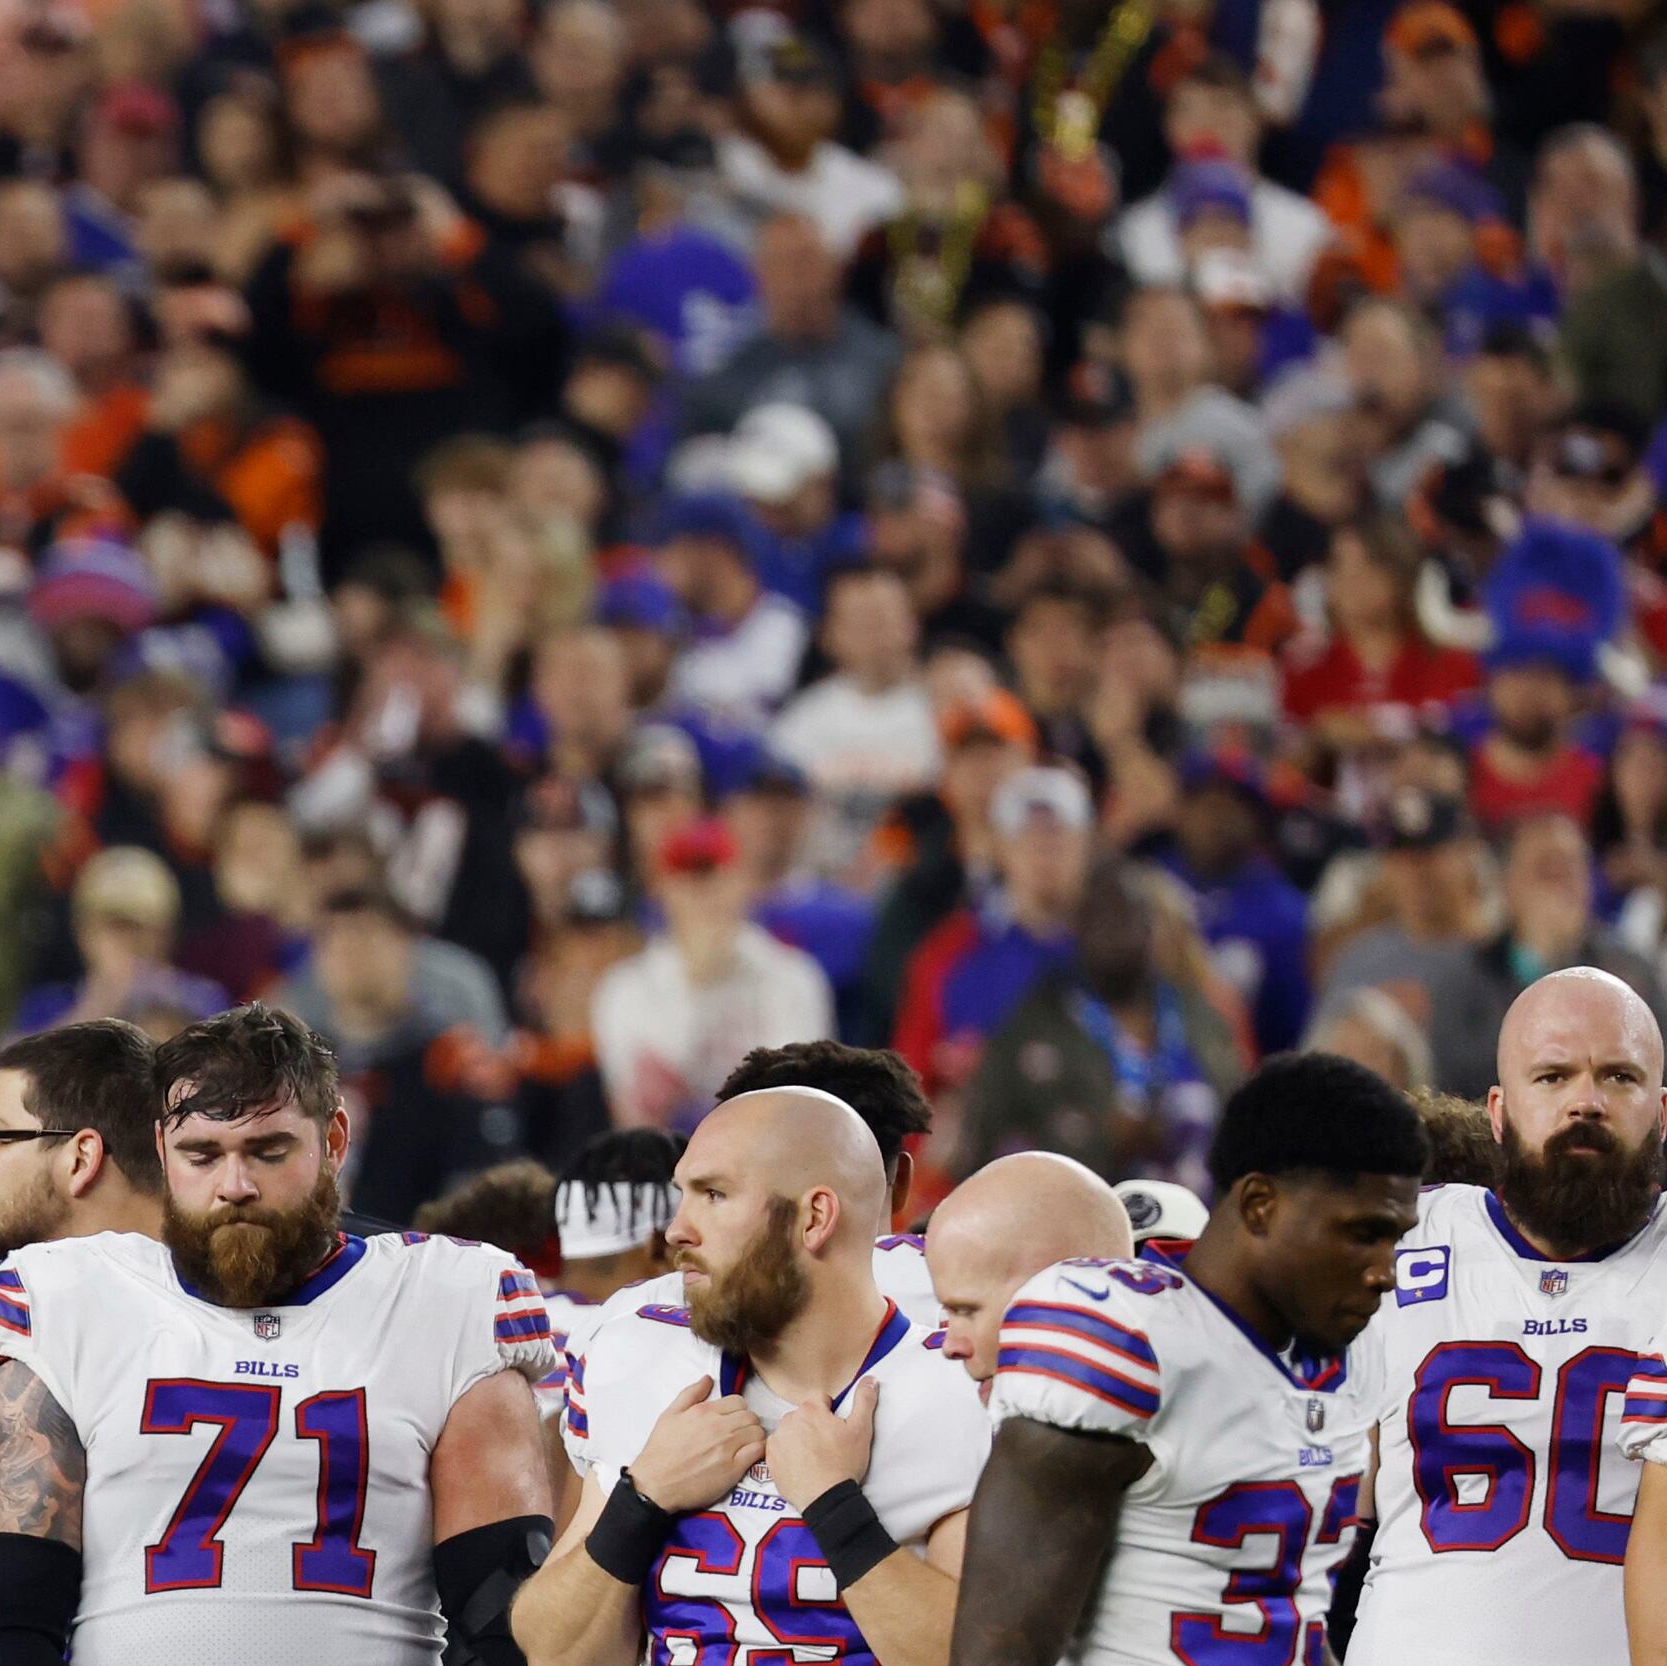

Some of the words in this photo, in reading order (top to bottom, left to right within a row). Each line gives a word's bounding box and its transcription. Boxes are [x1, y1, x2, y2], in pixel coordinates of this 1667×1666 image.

[1396, 1249, 1445, 1290] C
[1523, 1318, 1588, 1335] BILLS
[234, 1360, 299, 1378] BILLS
[1408, 1340, 1639, 1565] 60
[139, 1377, 376, 1599] 71
[729, 1491, 787, 1511] BILLS
